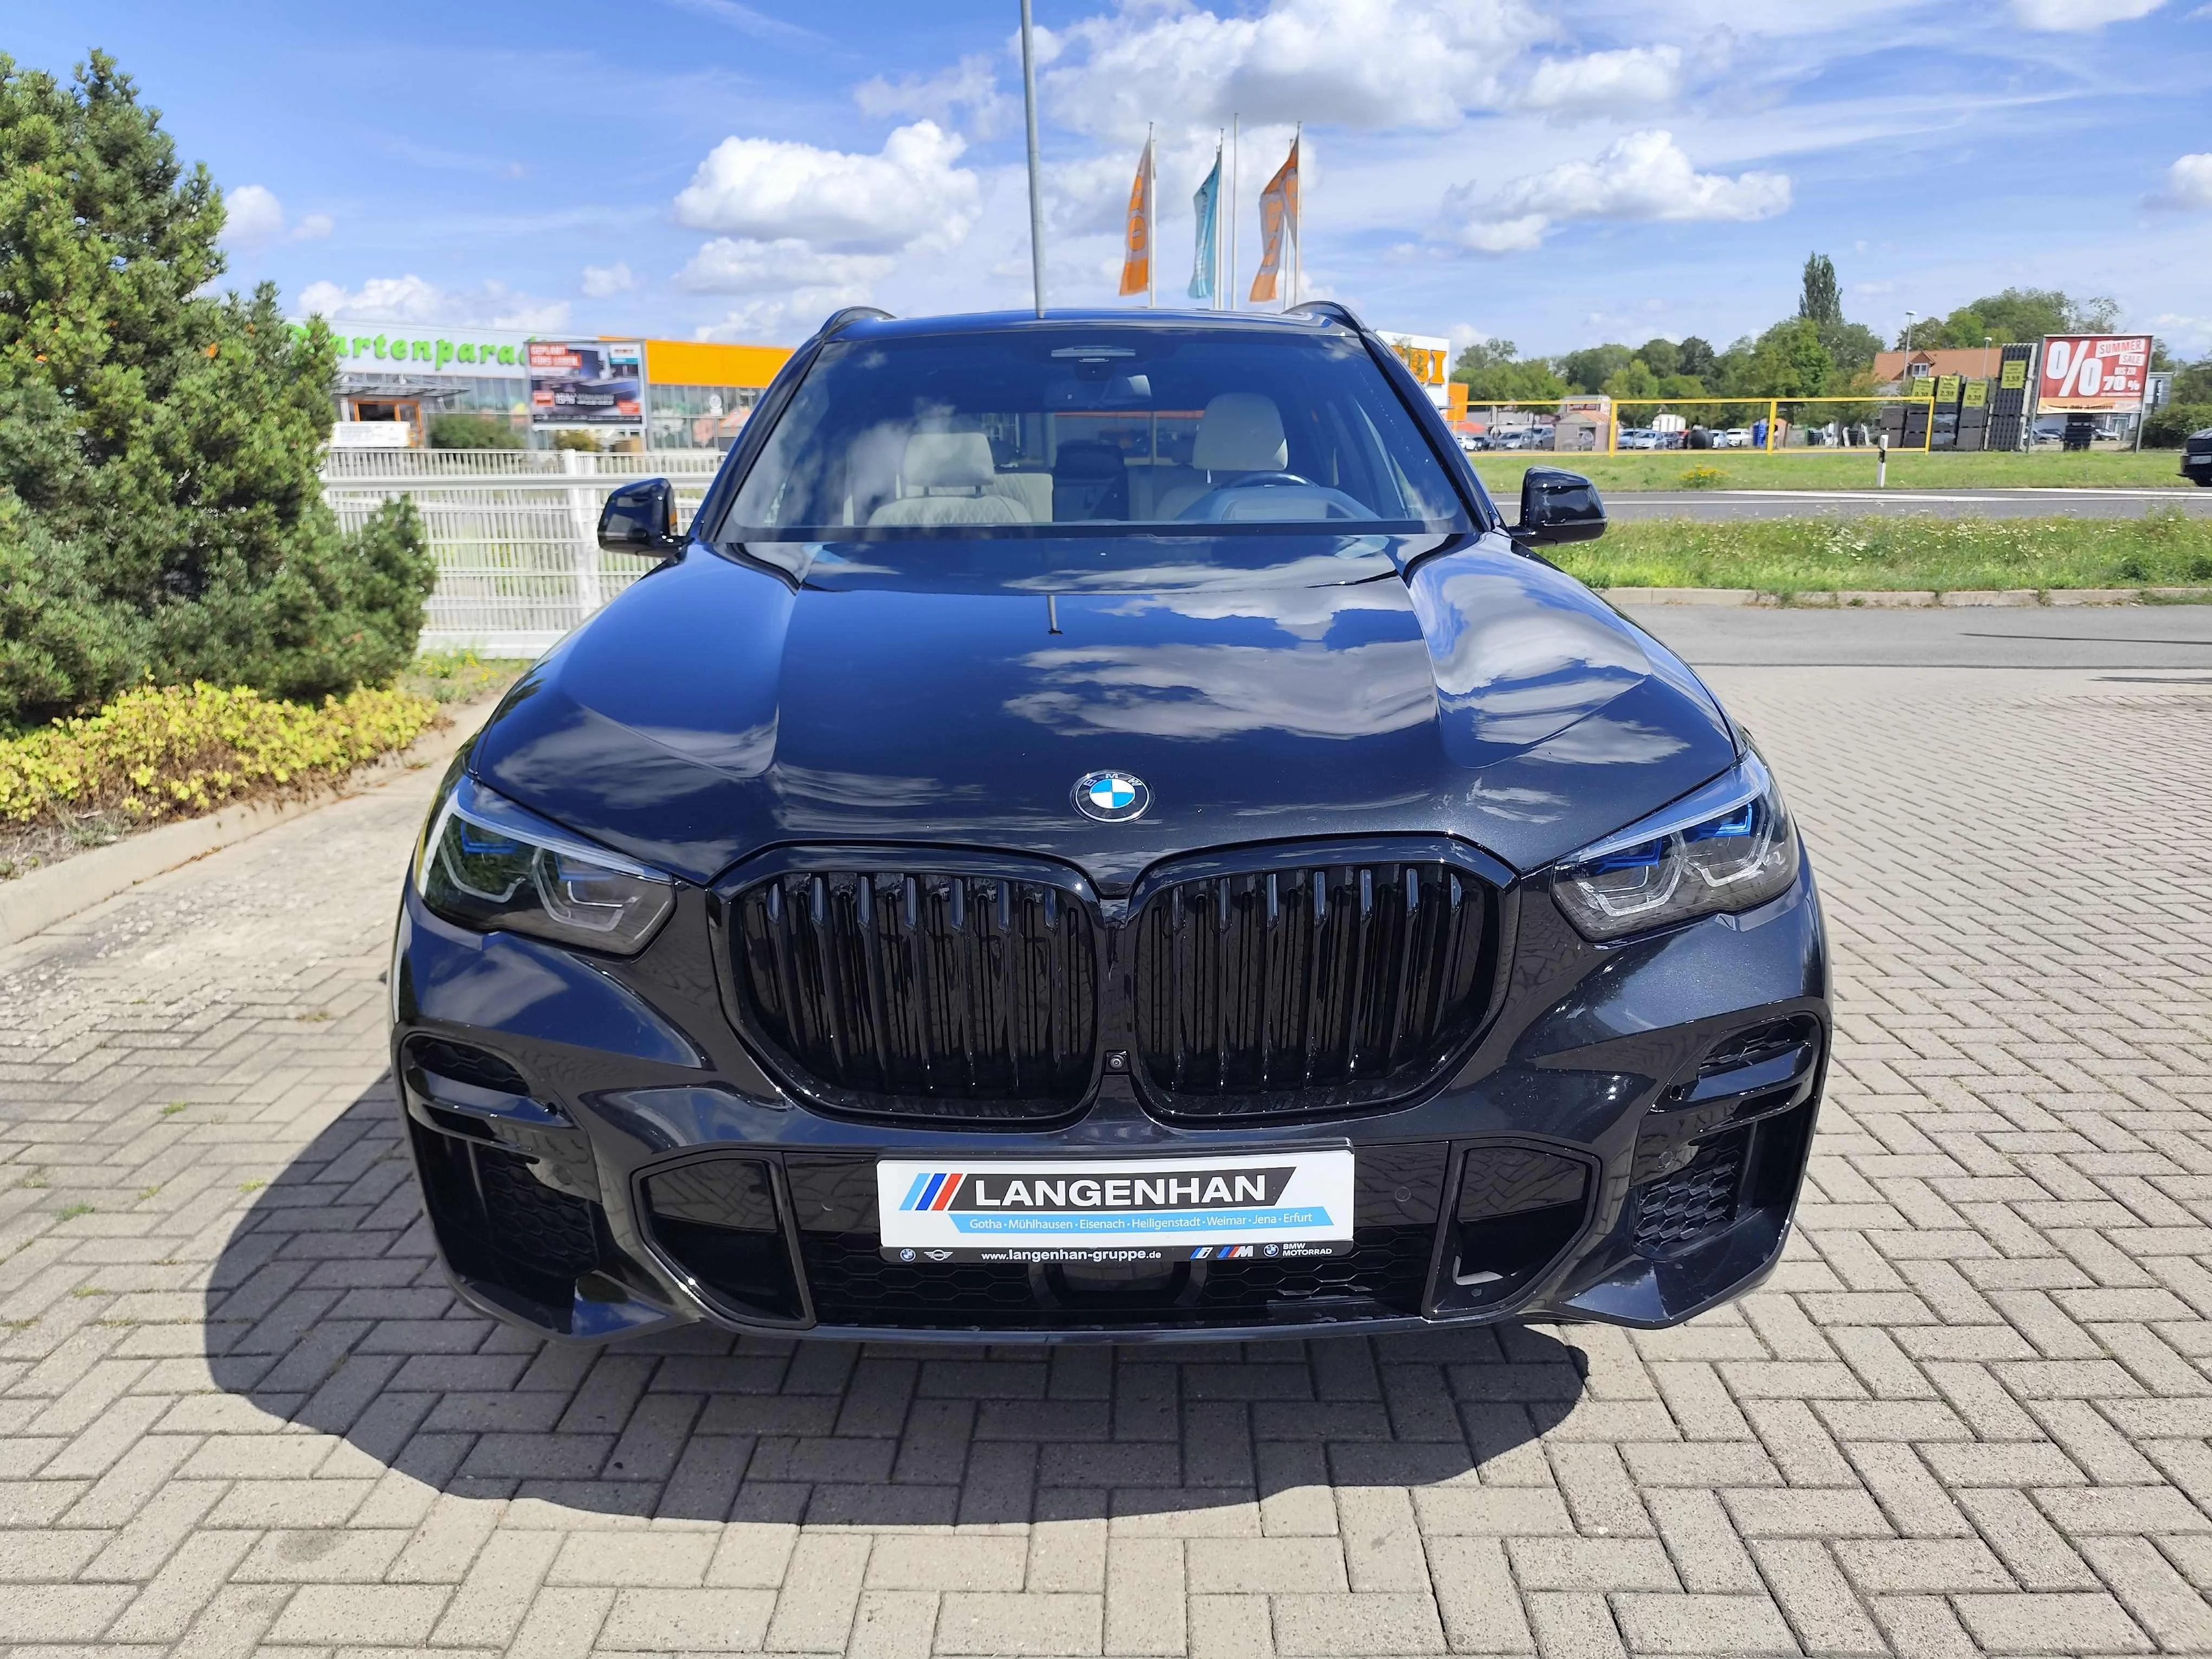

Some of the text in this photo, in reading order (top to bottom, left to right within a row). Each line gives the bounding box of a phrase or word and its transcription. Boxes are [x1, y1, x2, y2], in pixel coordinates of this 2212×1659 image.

[2099, 341, 2142, 354] SUMMER
[2122, 354, 2141, 364] SALE
[2103, 376, 2126, 390] 70
[1083, 773, 1142, 787] BMW
[975, 1175, 1265, 1206] LANGENHAN
[969, 1212, 1313, 1230] Gotha Mühlhausen Eisenach Heiligenstadt Weimar Jena Erfurt
[981, 1248, 1162, 1263] www.langenhan-gruppe.de
